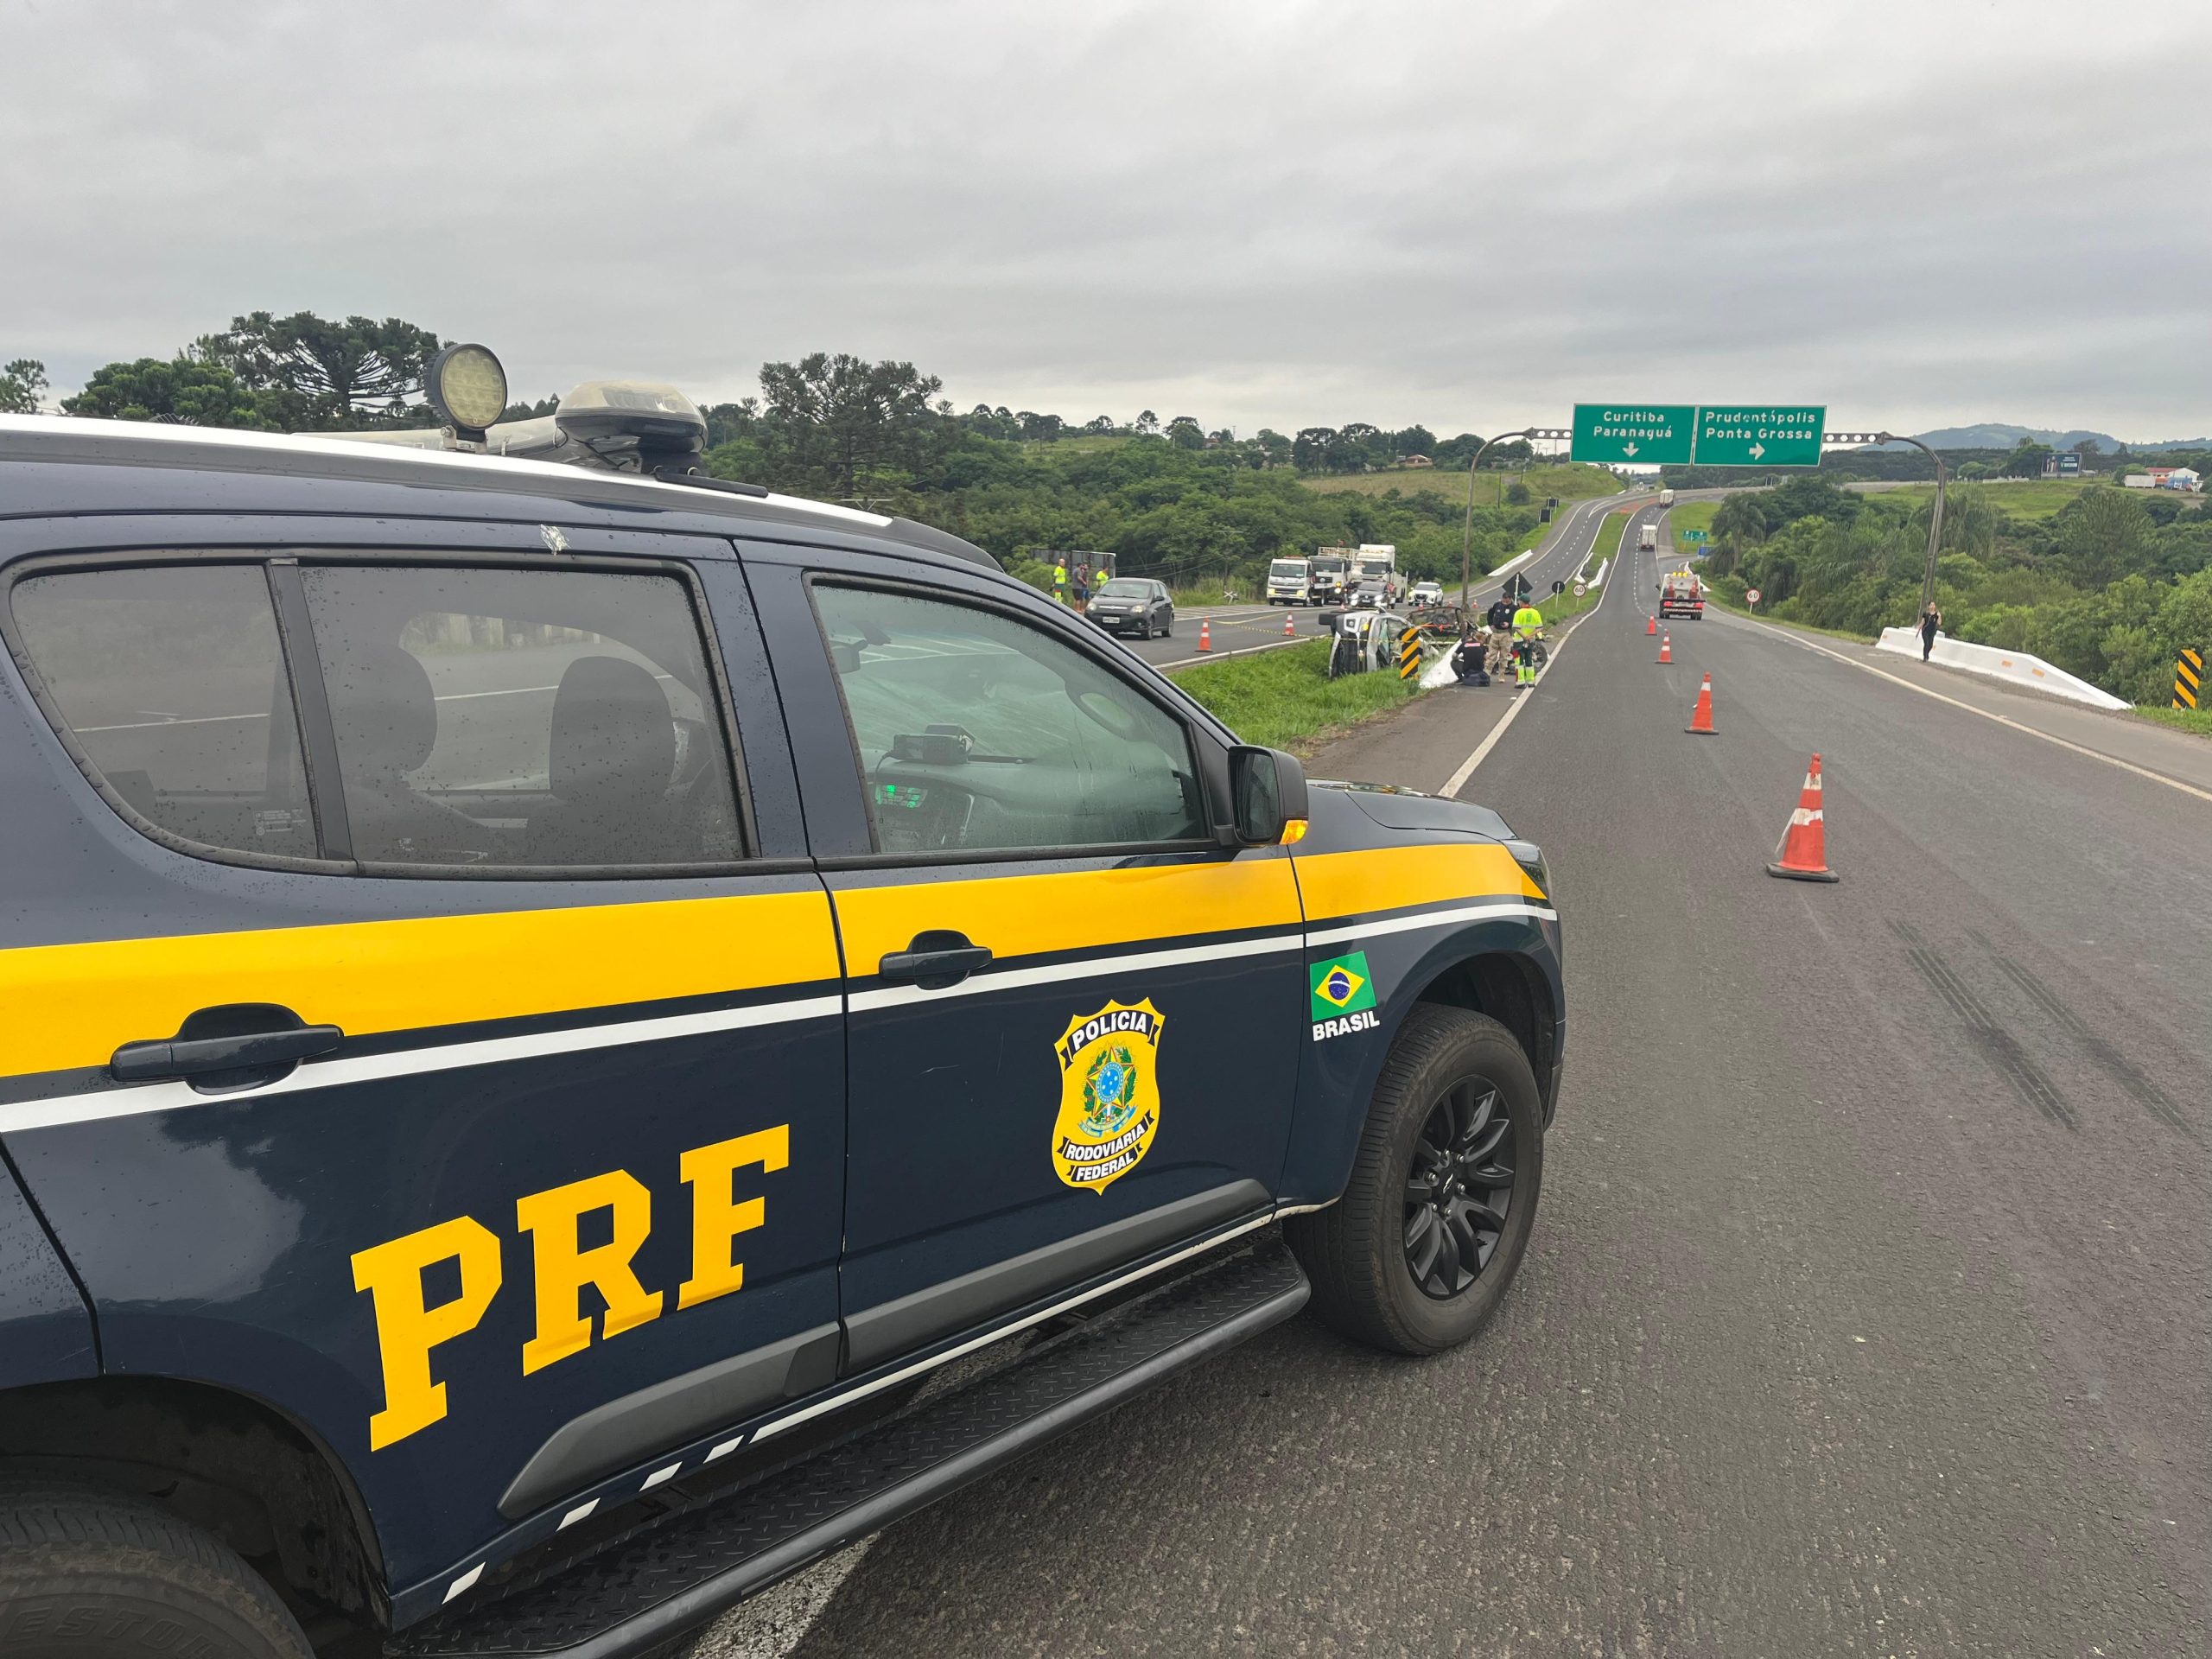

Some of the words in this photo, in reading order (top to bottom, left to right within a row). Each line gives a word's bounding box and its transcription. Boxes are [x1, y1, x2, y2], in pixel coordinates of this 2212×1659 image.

[1603, 410, 1664, 423] Curitiba
[1705, 410, 1815, 425] Prudentópolis
[1593, 424, 1672, 441] Paranaguá
[1706, 427, 1751, 439] Ponta
[1758, 428, 1812, 440] Grossa
[1313, 1010, 1381, 1042] BRASIL
[1076, 1152, 1134, 1181] FEDERAL
[351, 1123, 789, 1452] PRF
